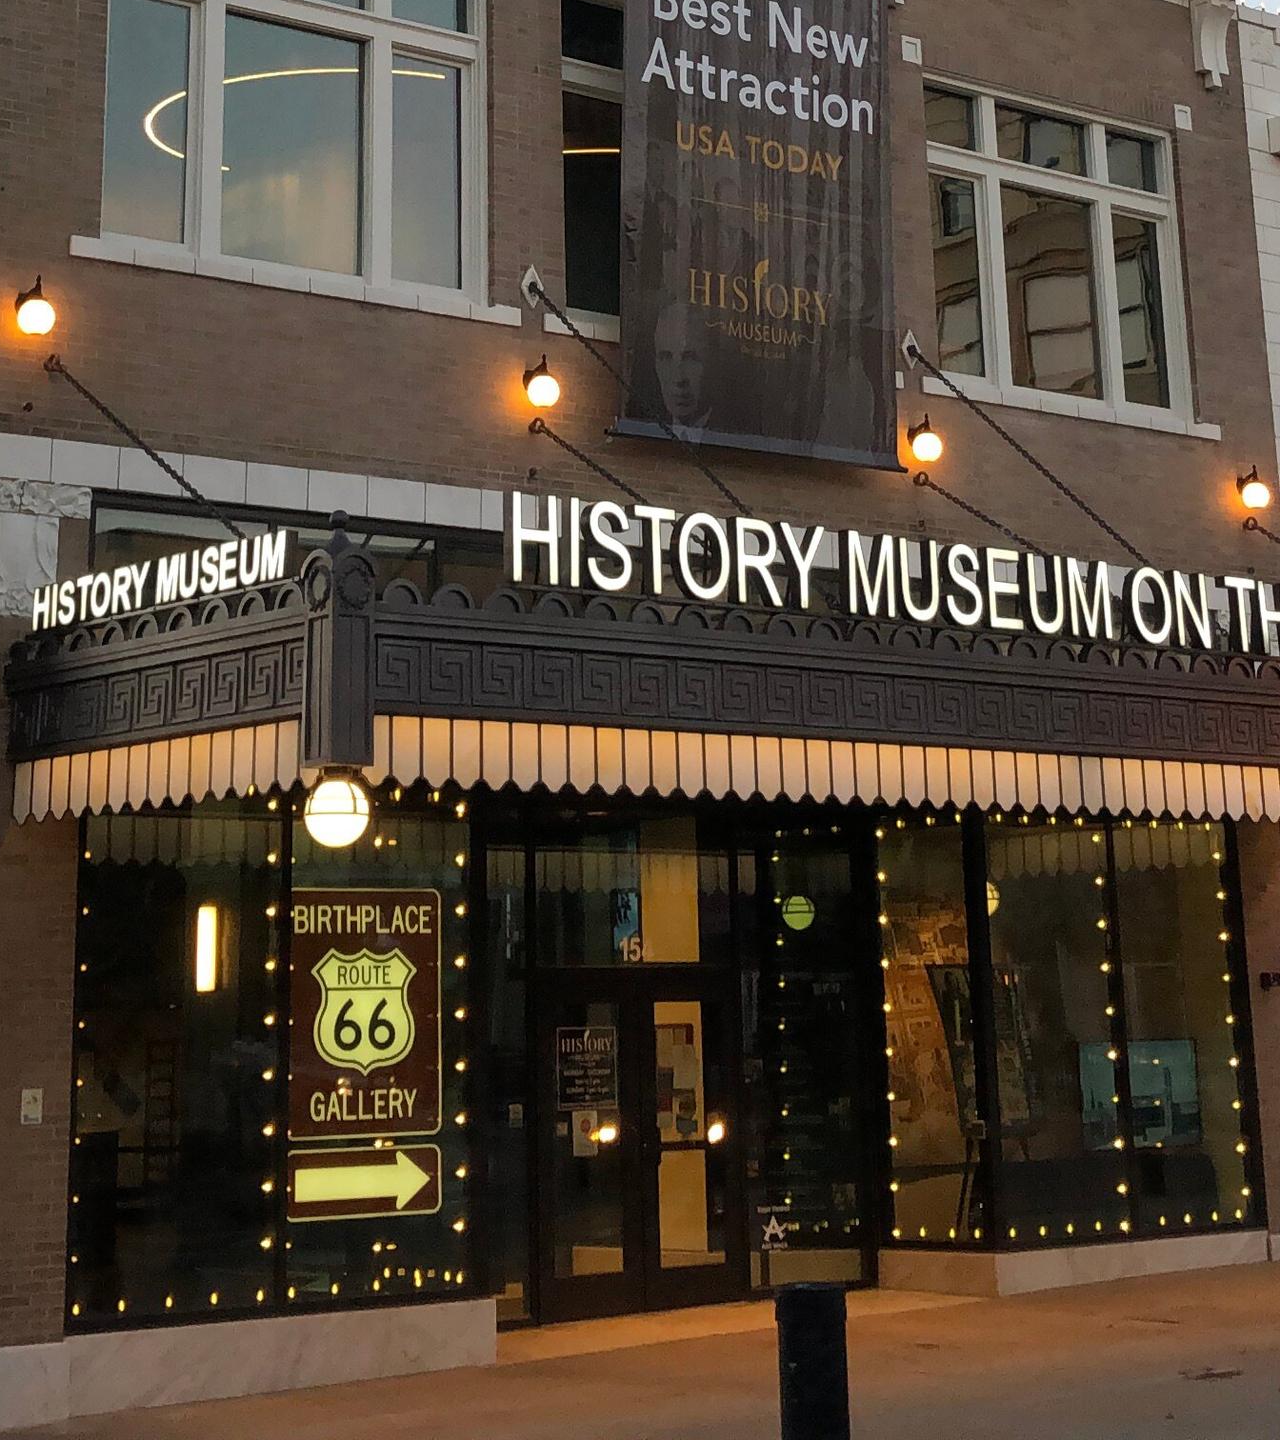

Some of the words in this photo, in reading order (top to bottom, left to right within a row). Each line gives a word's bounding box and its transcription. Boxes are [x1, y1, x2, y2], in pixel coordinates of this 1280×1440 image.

[769, 0, 869, 69] New
[641, 37, 874, 135] Attraction
[675, 120, 736, 160] USA
[744, 135, 844, 181] TODAY
[688, 258, 832, 327] HISTORY
[728, 321, 798, 348] MUSEUM
[31, 559, 152, 632] HISTORY
[154, 529, 287, 602] MUSEUM
[513, 491, 825, 610] HISTORY
[846, 529, 1114, 642] MUSEUM
[1131, 566, 1214, 650] ON
[293, 904, 432, 935] BIRTHPLACE
[337, 965, 392, 985] ROUTE
[333, 997, 396, 1051] 66
[310, 1087, 417, 1122] GALLERY
